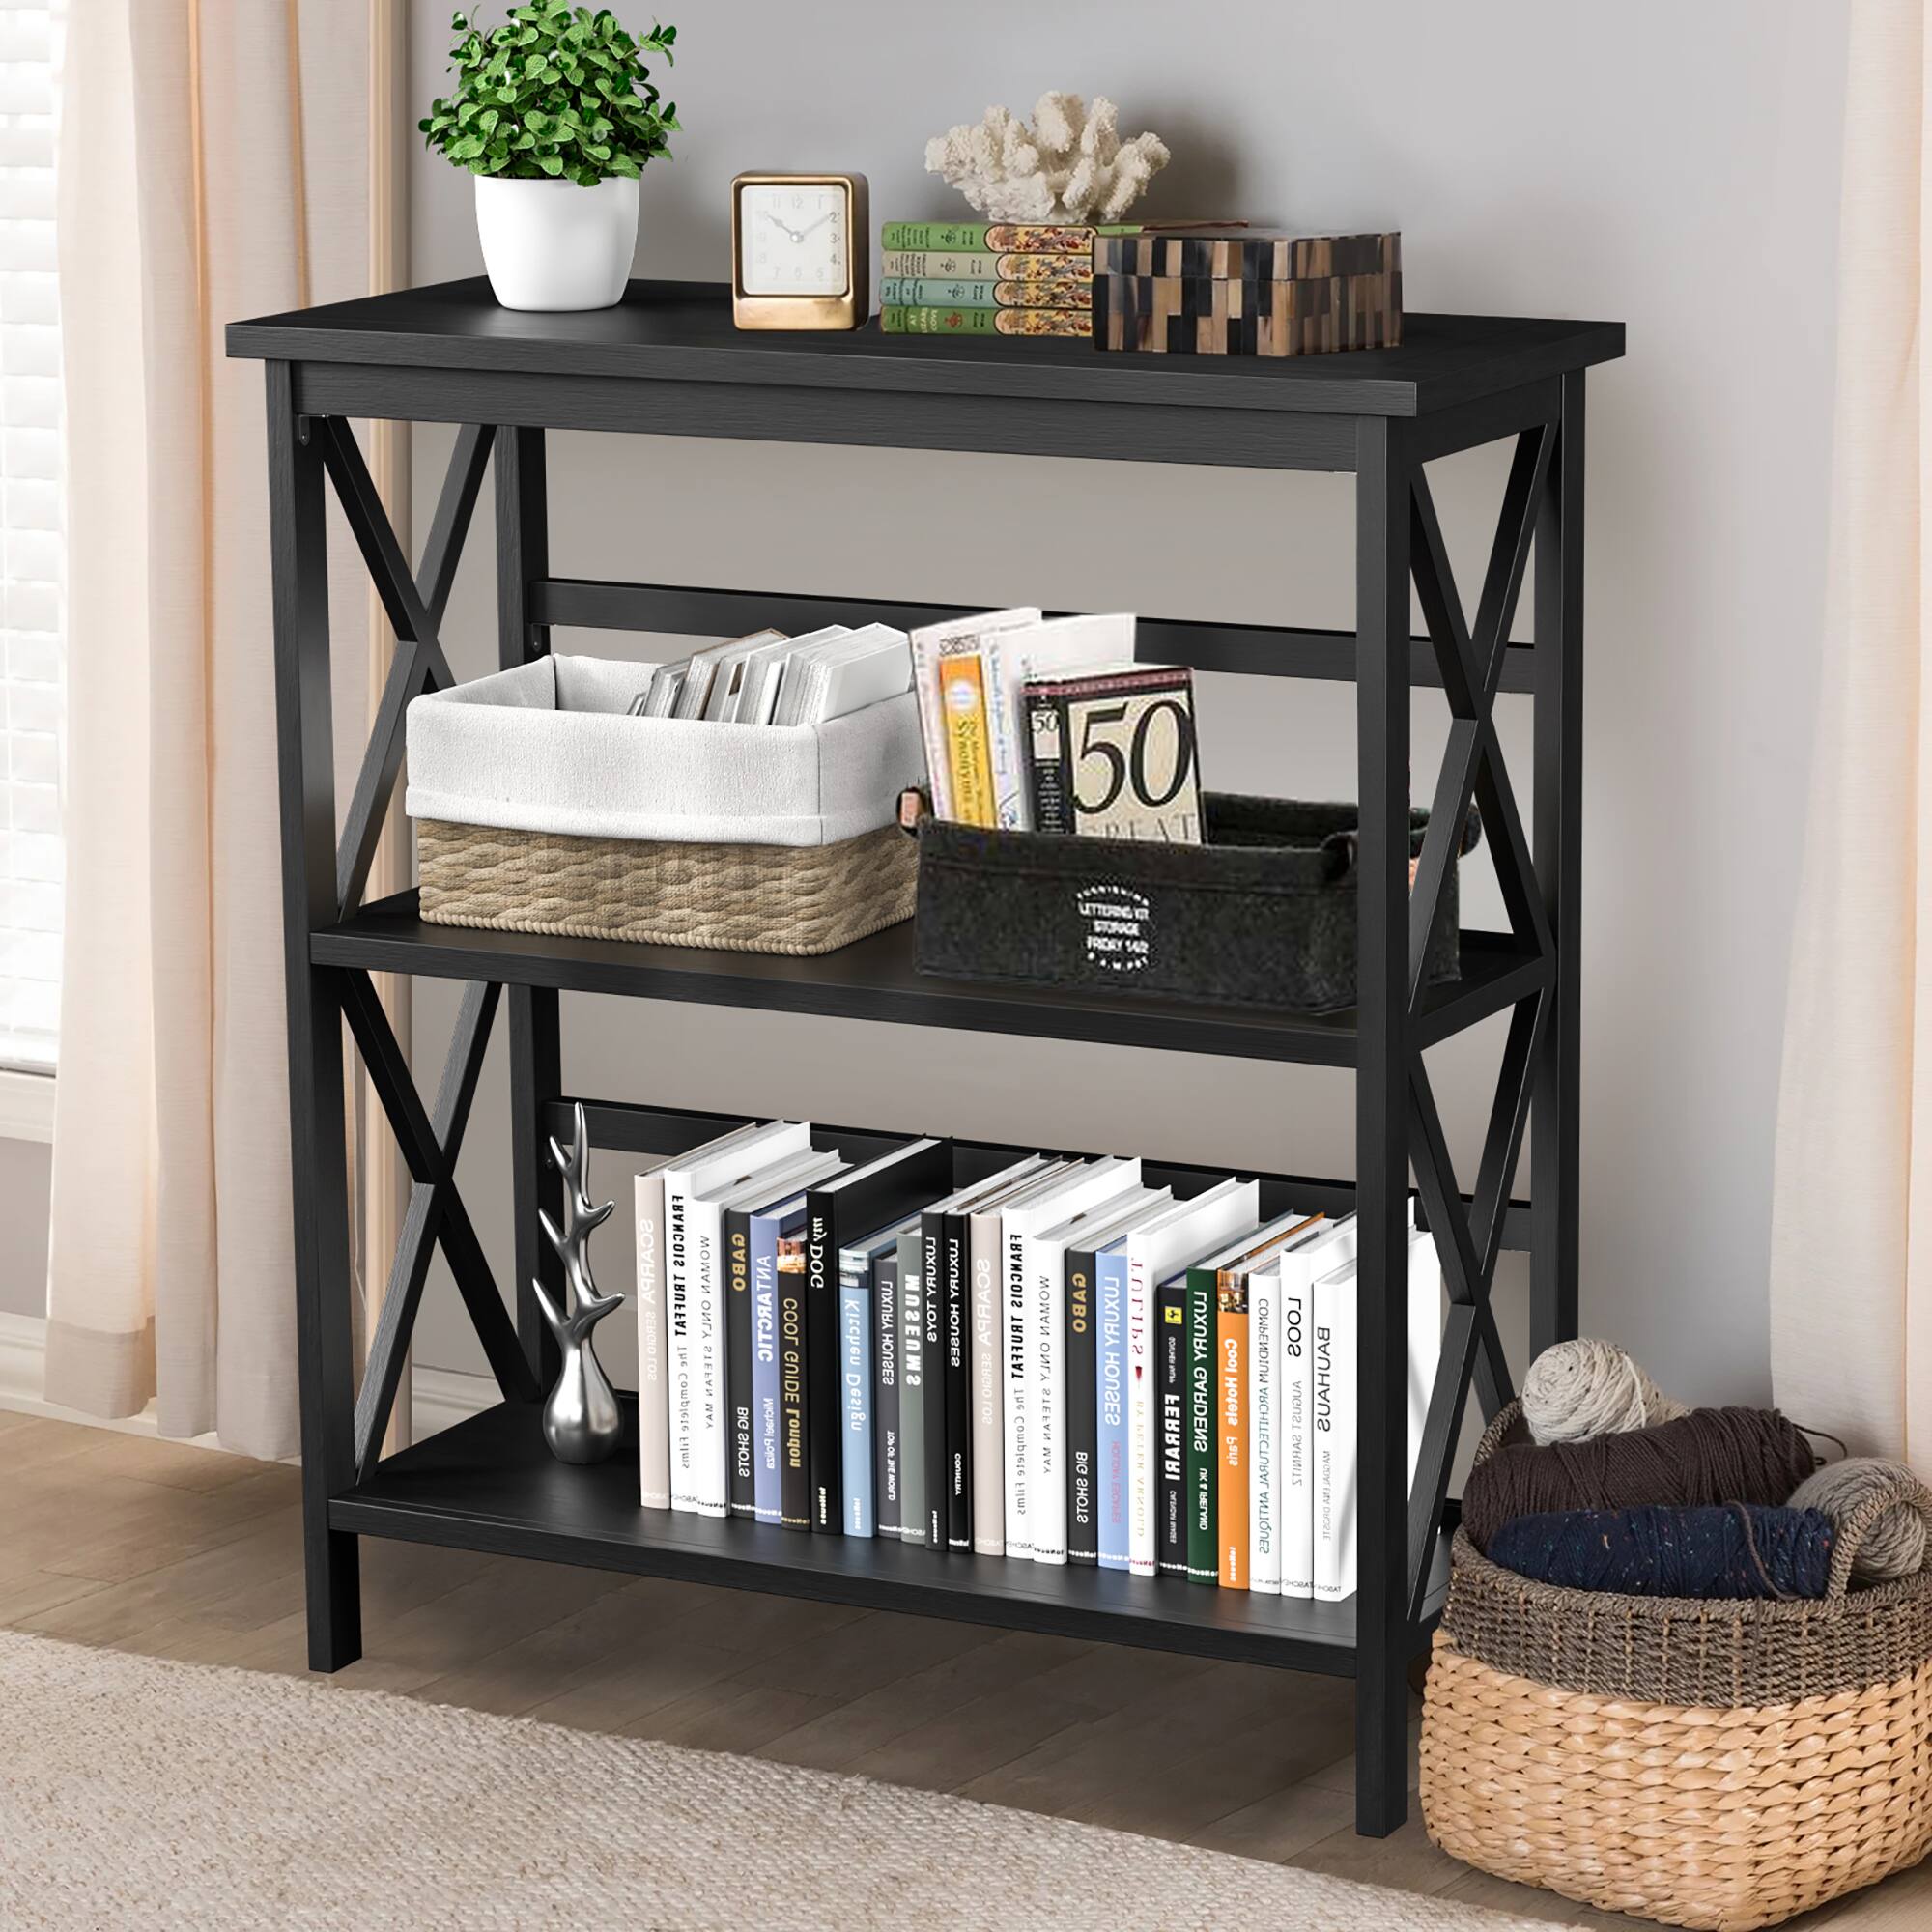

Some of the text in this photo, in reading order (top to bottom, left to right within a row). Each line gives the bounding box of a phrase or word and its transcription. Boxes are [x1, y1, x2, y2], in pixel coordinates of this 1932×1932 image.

[792, 193, 804, 209] 12
[830, 212, 837, 223] 2
[830, 233, 837, 243] 3
[830, 253, 837, 265] 4
[910, 314, 917, 325] AT
[1033, 713, 1059, 734] 50
[1073, 699, 1194, 815] 50
